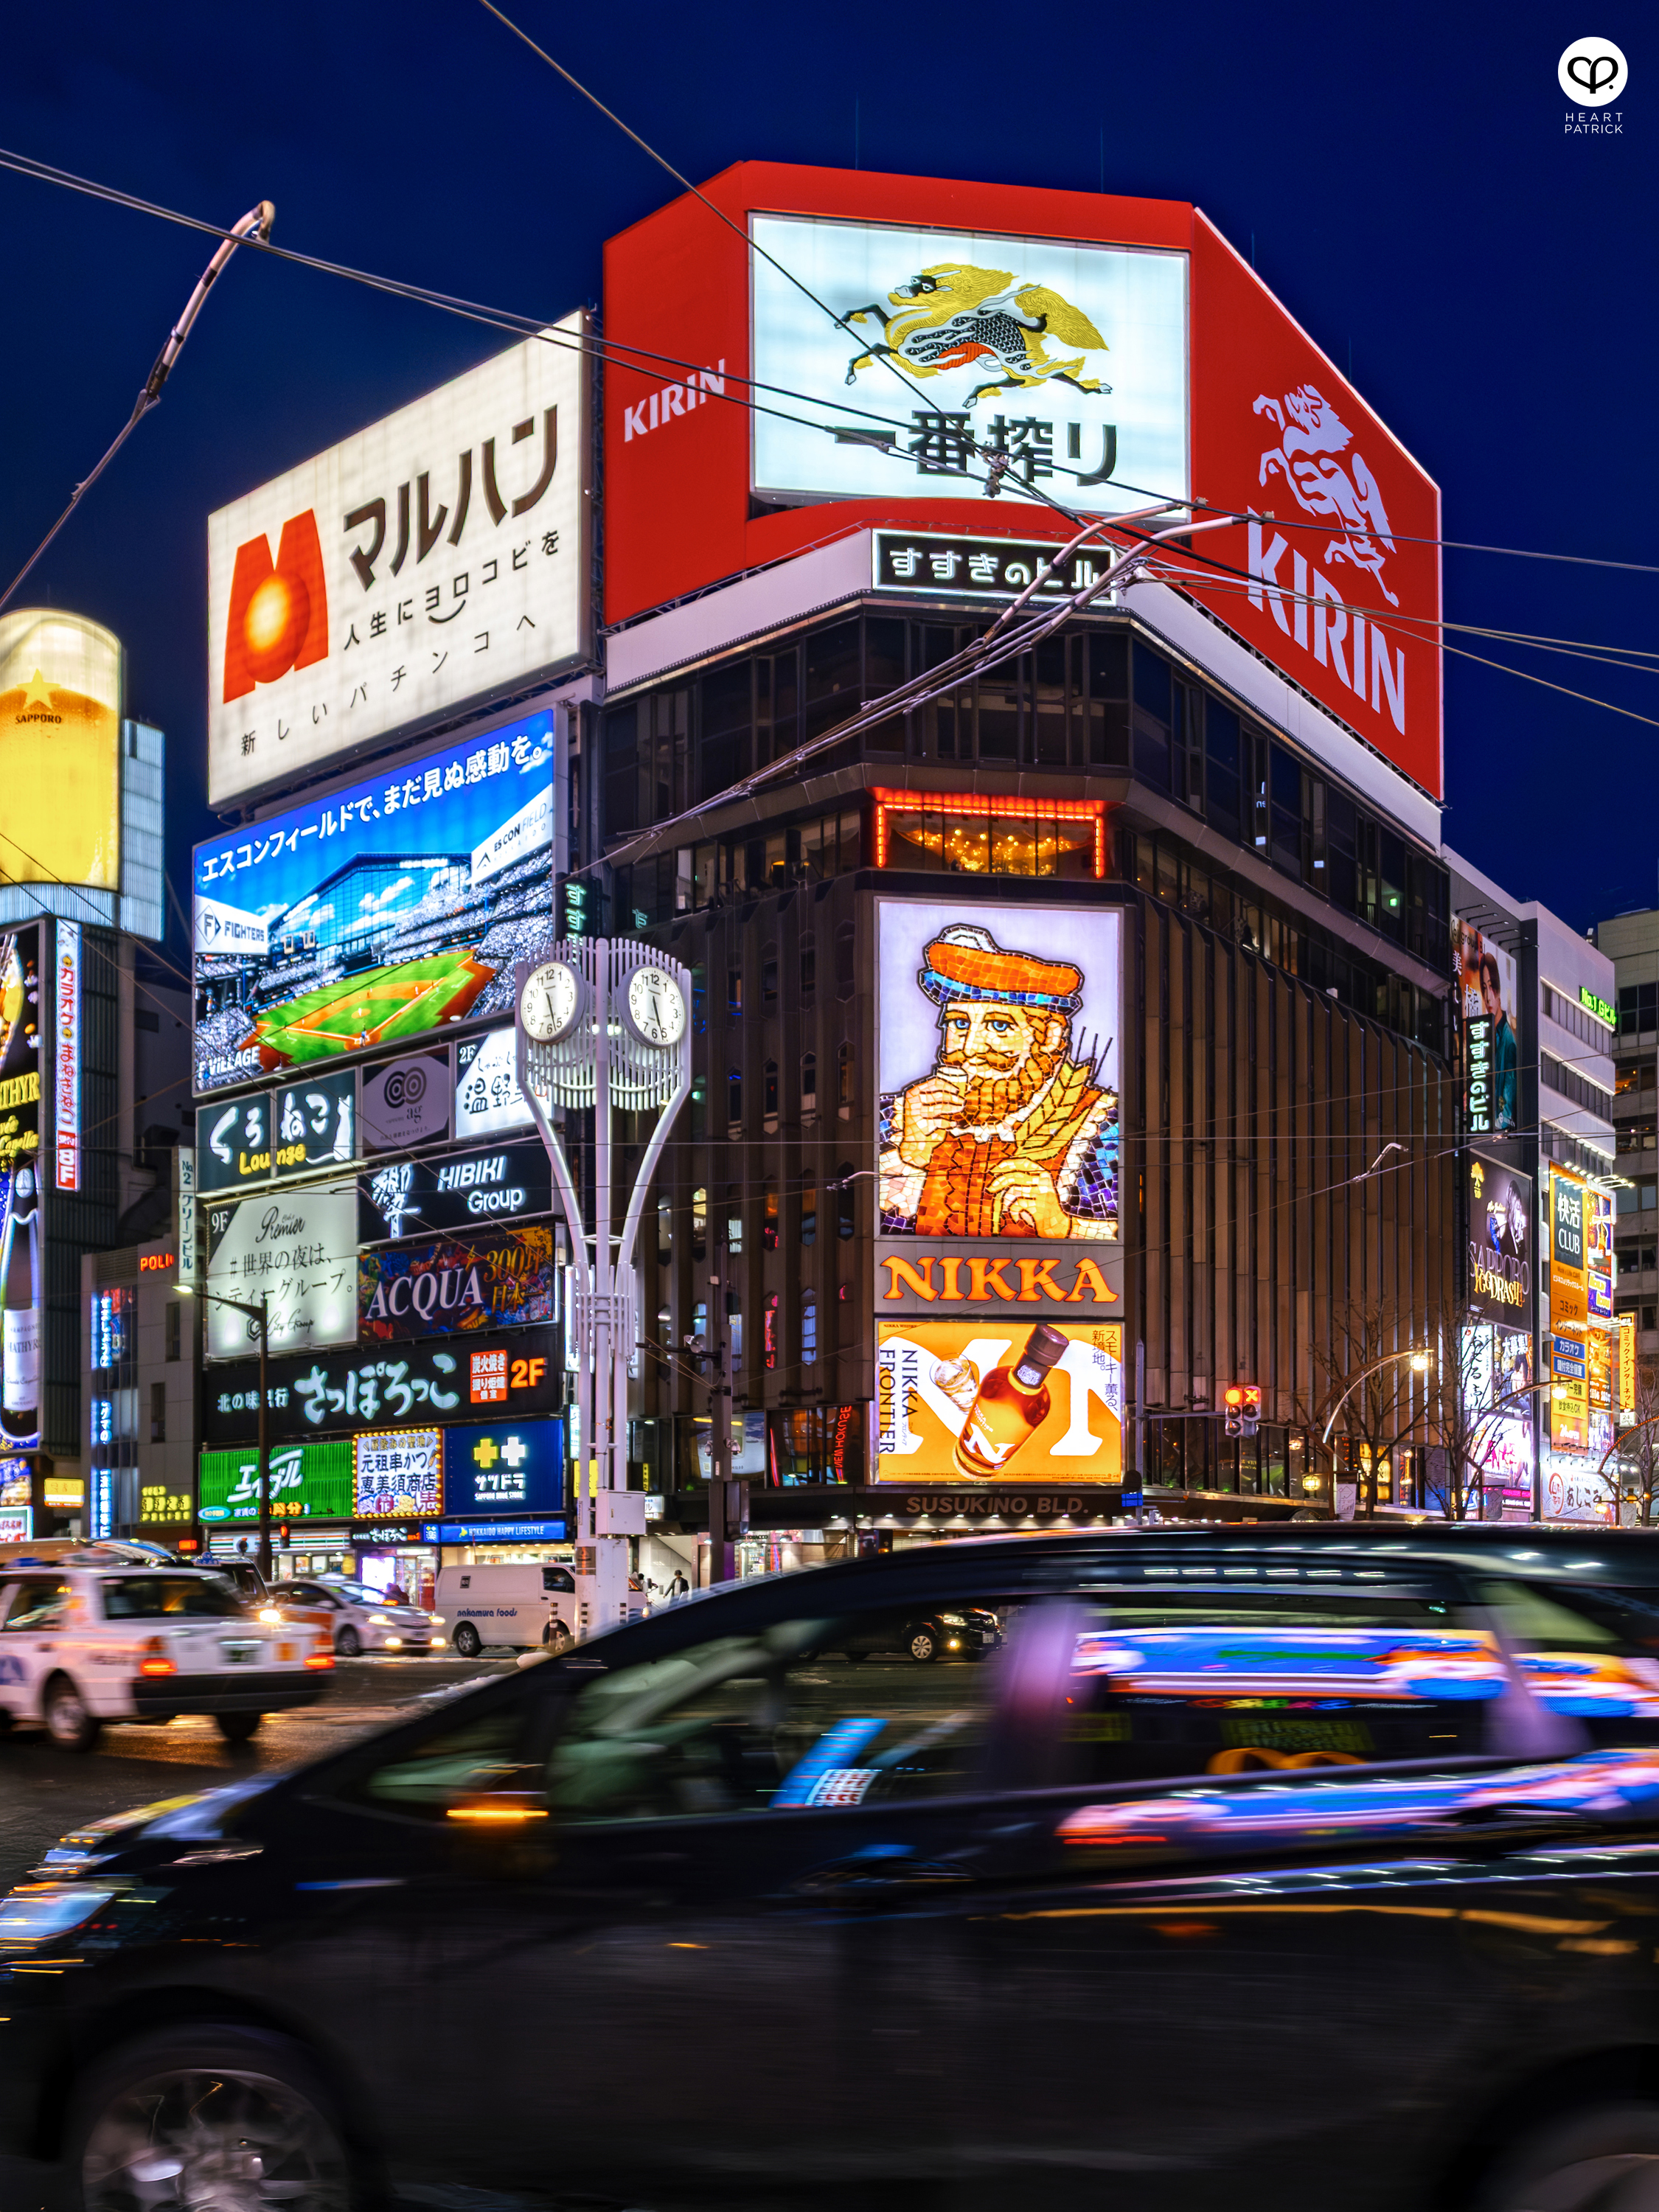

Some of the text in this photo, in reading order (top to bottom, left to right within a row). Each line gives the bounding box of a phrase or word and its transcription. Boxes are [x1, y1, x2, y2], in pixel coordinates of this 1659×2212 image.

[624, 358, 726, 442] KIRIN
[834, 409, 1117, 487] 一番搾り
[343, 403, 558, 592] マルハン
[344, 530, 560, 651] 人生にヨロコビを
[1248, 505, 1405, 736] KIRIN
[240, 614, 536, 757] 新しいパチンコへ
[15, 714, 62, 725] SAPPORO
[202, 734, 543, 883] エスコンフィールドで、まだ見ぬ感動を。
[522, 802, 547, 832] FIELD
[224, 920, 265, 942] FIGHTERS
[536, 976, 544, 987] 11
[544, 969, 554, 980] 12
[633, 983, 644, 994] 10
[641, 974, 649, 986] 11
[650, 973, 660, 986] 12
[59, 968, 75, 1026] カラオケ
[529, 988, 539, 998] 10
[459, 1043, 478, 1064] 2F
[58, 1043, 76, 1127] まねきねこ
[209, 1092, 330, 1164] くろねこ
[58, 1148, 74, 1183] 8F
[239, 1144, 306, 1175] Lounge
[437, 1155, 507, 1192] HIBIKI
[467, 1187, 526, 1214] Group
[1557, 1192, 1581, 1229] 快活
[211, 1210, 229, 1234] 9F
[255, 1206, 306, 1244] Premier
[1558, 1228, 1580, 1255] CLUB
[880, 1255, 1119, 1304] NIKKA
[1470, 1241, 1531, 1295] SAPPORO
[364, 1265, 484, 1321] ACQUA
[1559, 1300, 1578, 1316] コミック
[1555, 1318, 1582, 1337] インターネット
[1092, 1329, 1105, 1371] 新境地。
[1502, 1333, 1528, 1357] 大募集!
[1559, 1339, 1579, 1356] カラオケ
[472, 1352, 506, 1374] 炭火焼き
[510, 1357, 545, 1388] 2F
[1105, 1330, 1118, 1411] スモーキー薫る、
[1623, 1327, 1631, 1408] コミック・インターネット
[294, 1354, 459, 1424] さっぽろっこ
[901, 1349, 918, 1419] NIKKA
[879, 1349, 896, 1454] FRONTIER
[370, 1434, 426, 1452] 昼飲みの聖地
[361, 1451, 428, 1473] 元祖串かつ
[360, 1472, 437, 1495] 恵美須商店
[474, 1472, 526, 1491] サツドラ
[906, 1497, 1090, 1514] SUSUKINO BLD.
[468, 1525, 544, 1537] HOKKAIDO HAPPY LIFESTYLE
[457, 1607, 518, 1617] nakamura foods
